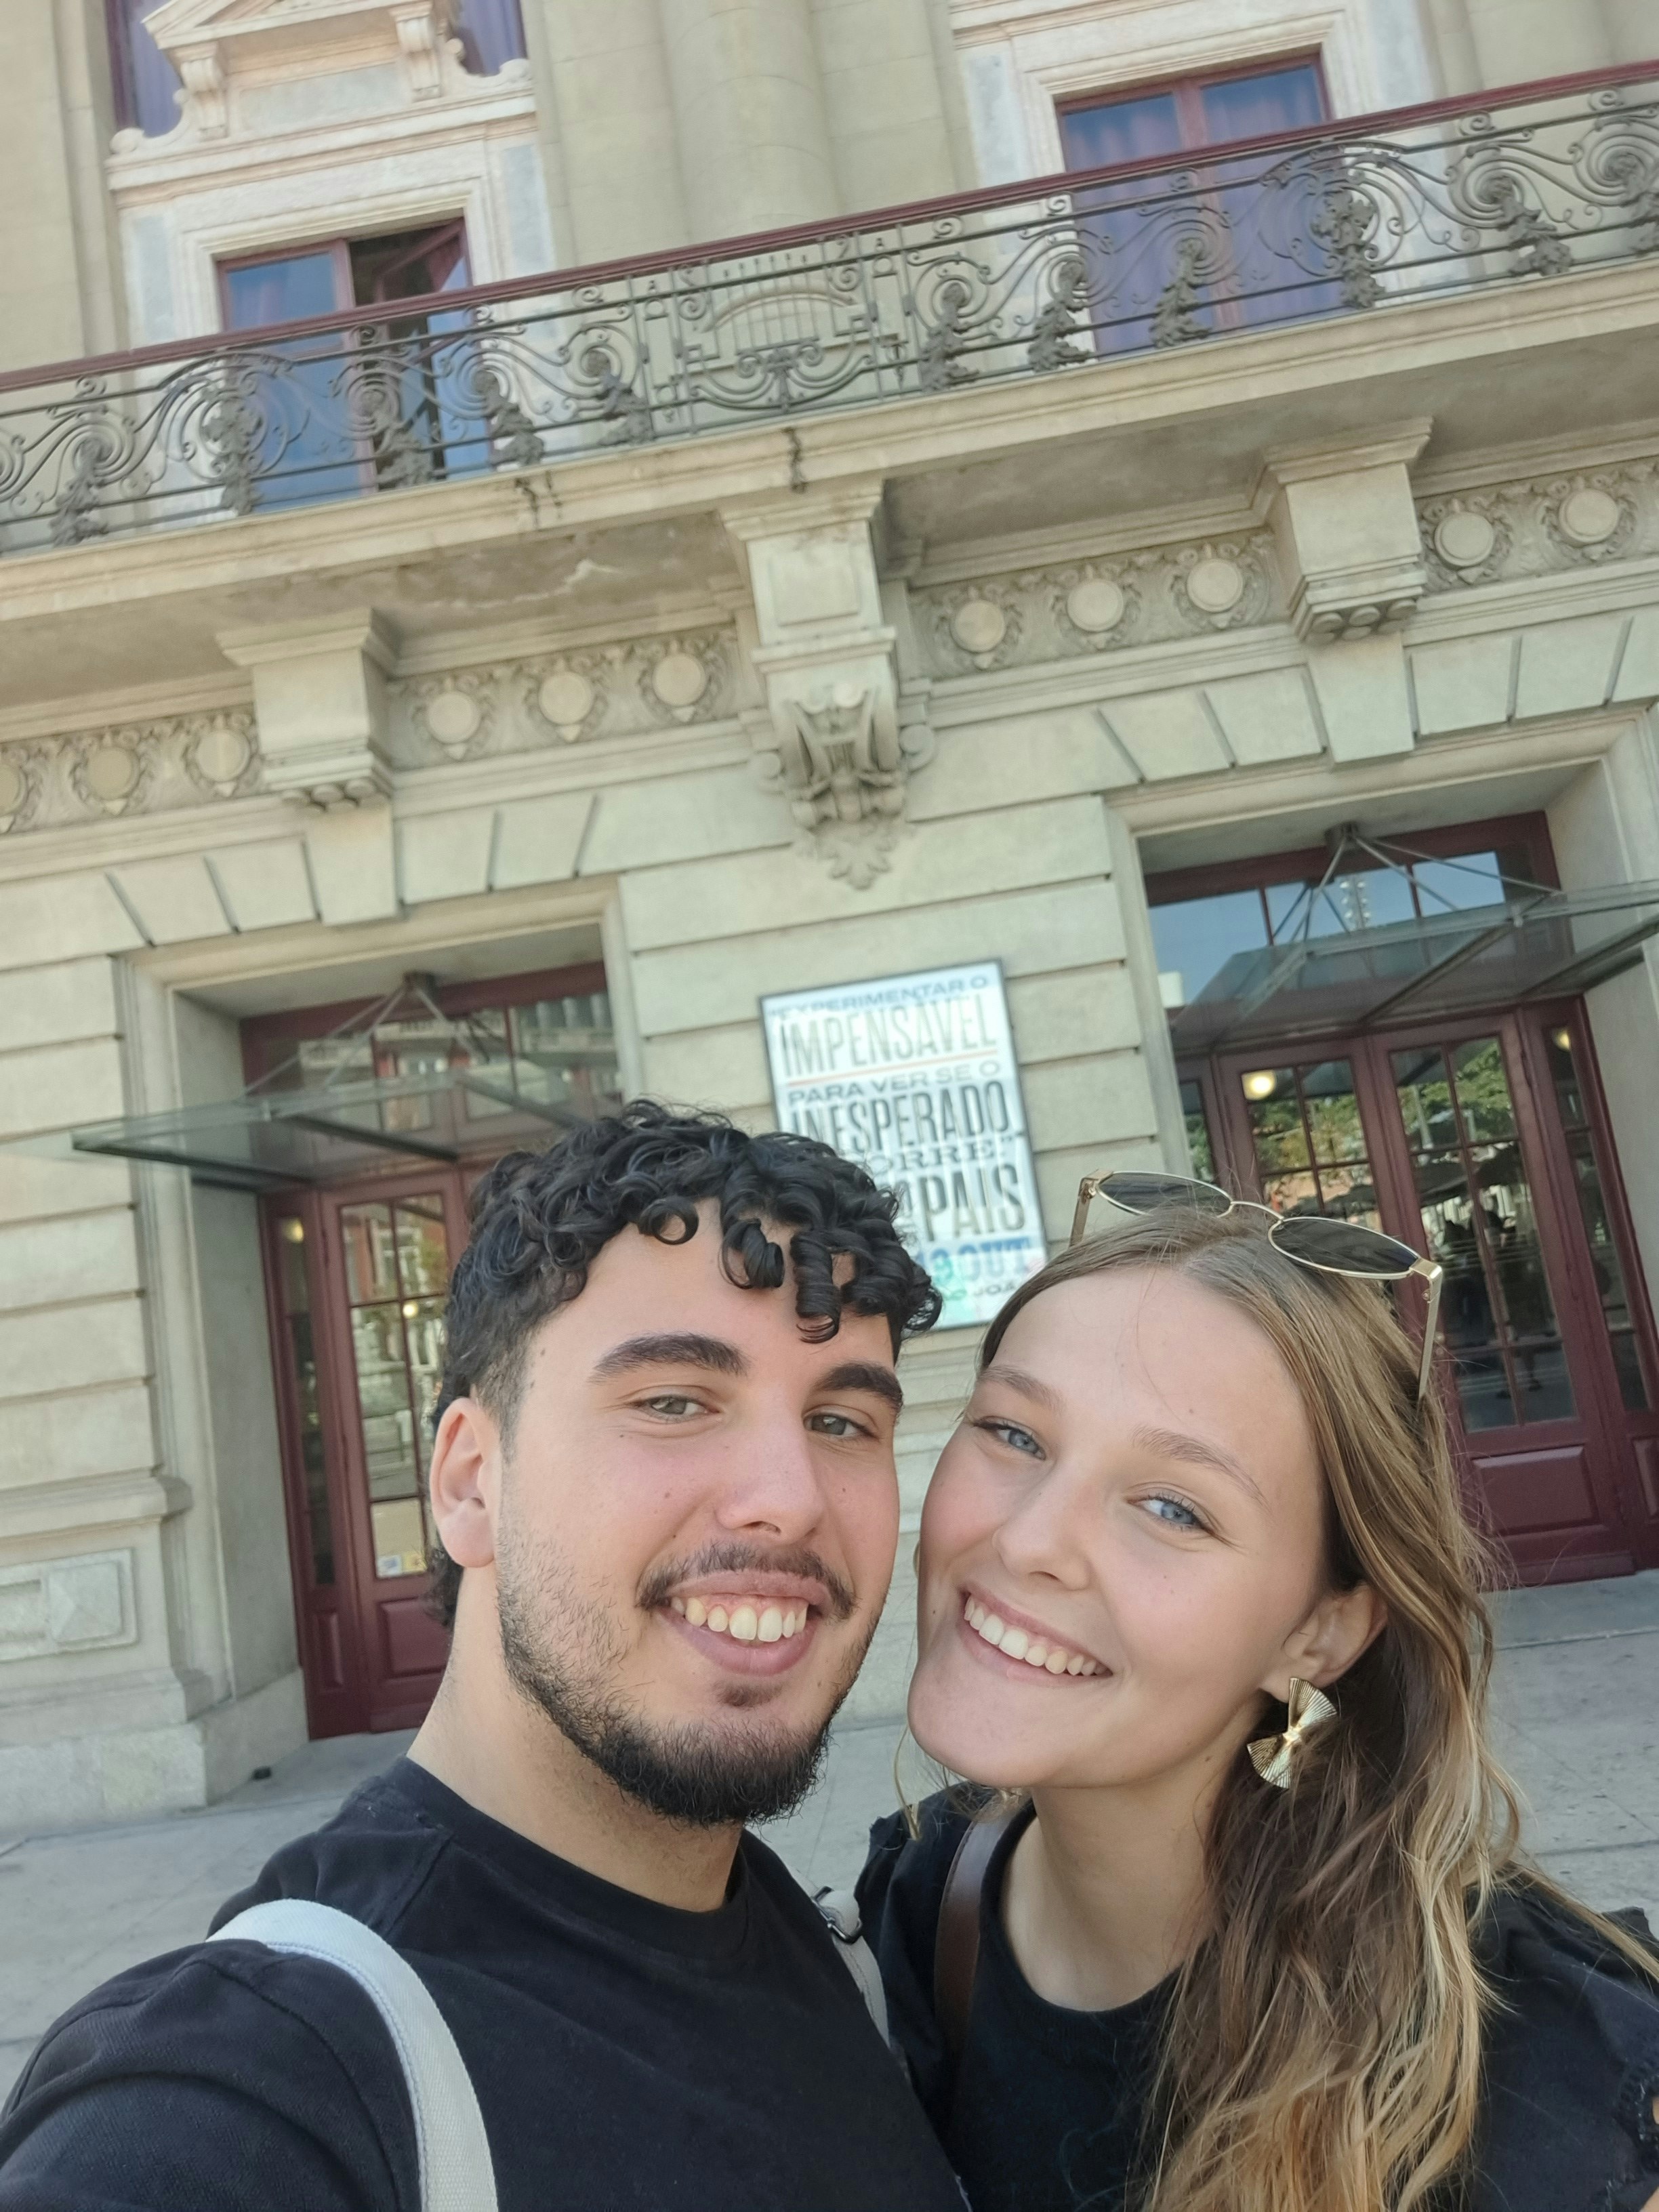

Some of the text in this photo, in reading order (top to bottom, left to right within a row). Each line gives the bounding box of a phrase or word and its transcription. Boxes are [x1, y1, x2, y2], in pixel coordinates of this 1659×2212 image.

[970, 976, 989, 989] O
[787, 1059, 1001, 1105] PARA VER SE O
[958, 1235, 1031, 1282] OUT
